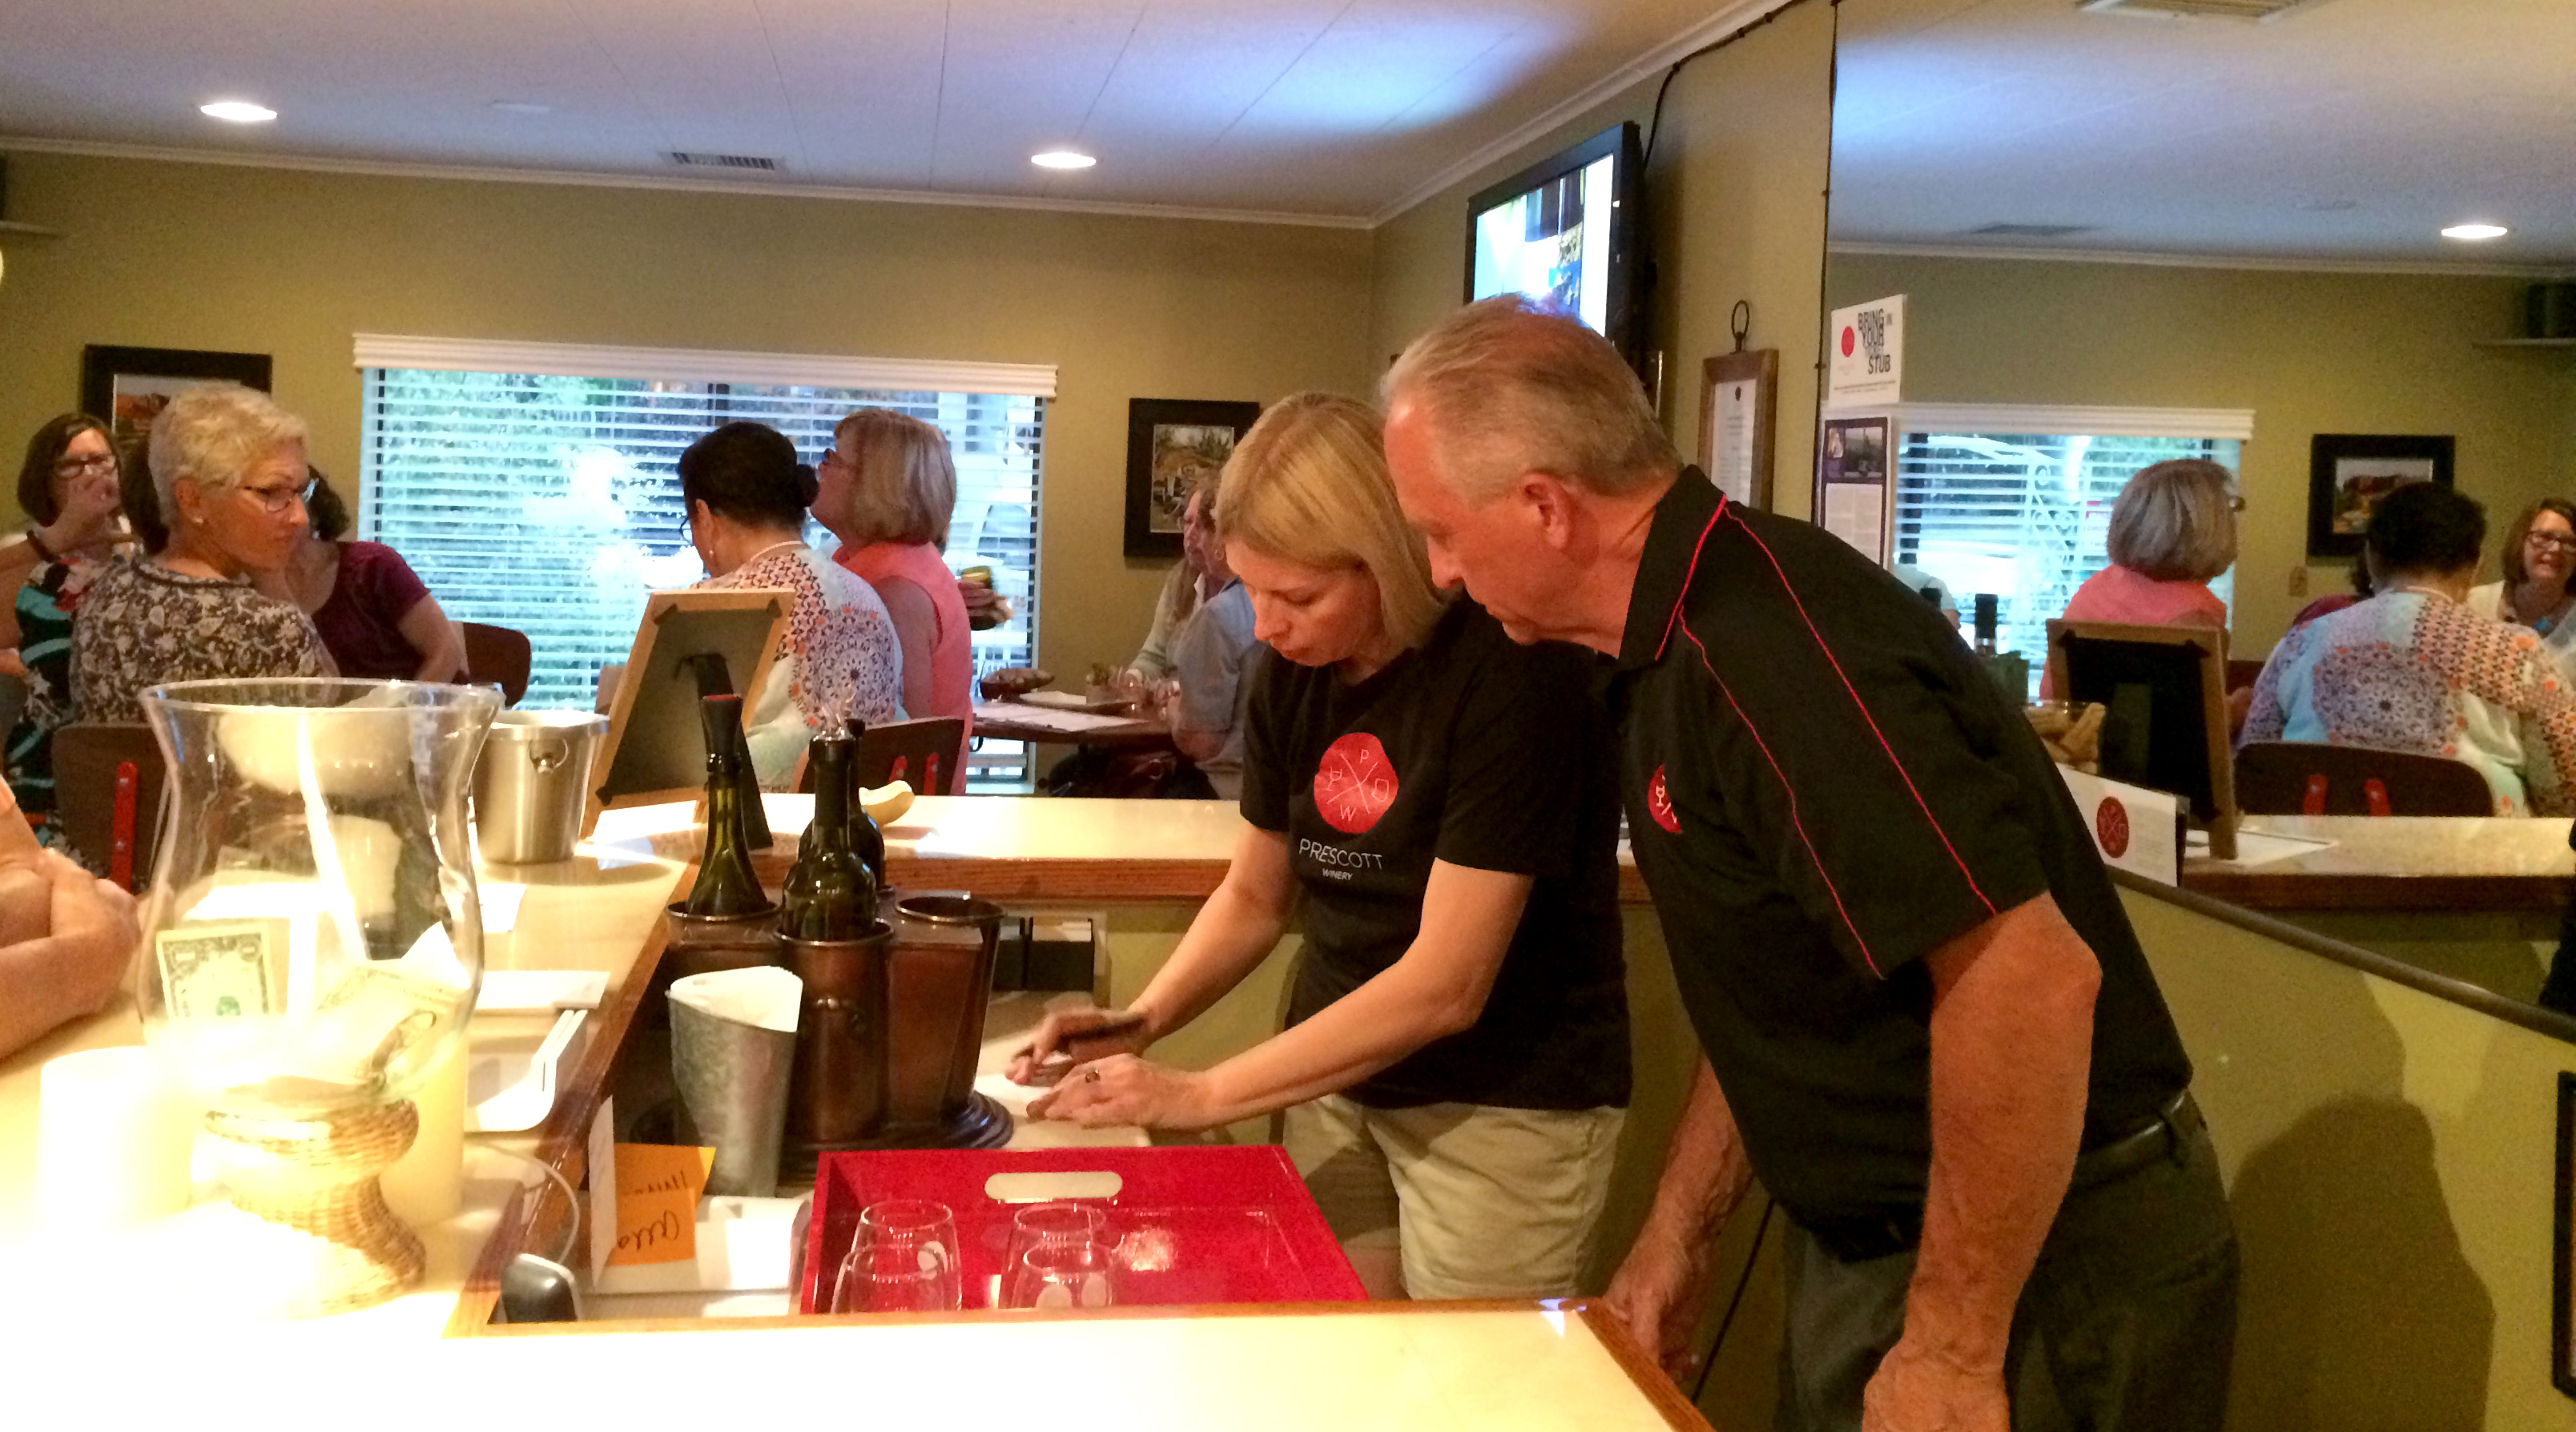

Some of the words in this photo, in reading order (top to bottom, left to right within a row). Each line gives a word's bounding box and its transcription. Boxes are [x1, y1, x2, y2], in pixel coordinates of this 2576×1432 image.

[1858, 308, 1884, 331] BRING
[1862, 324, 1884, 348] YOUR
[1868, 354, 1890, 375] STUB
[1360, 749, 1369, 763] P
[1340, 804, 1357, 822] W
[1298, 838, 1383, 870] PRESCOTT
[1322, 868, 1353, 881] WINERY
